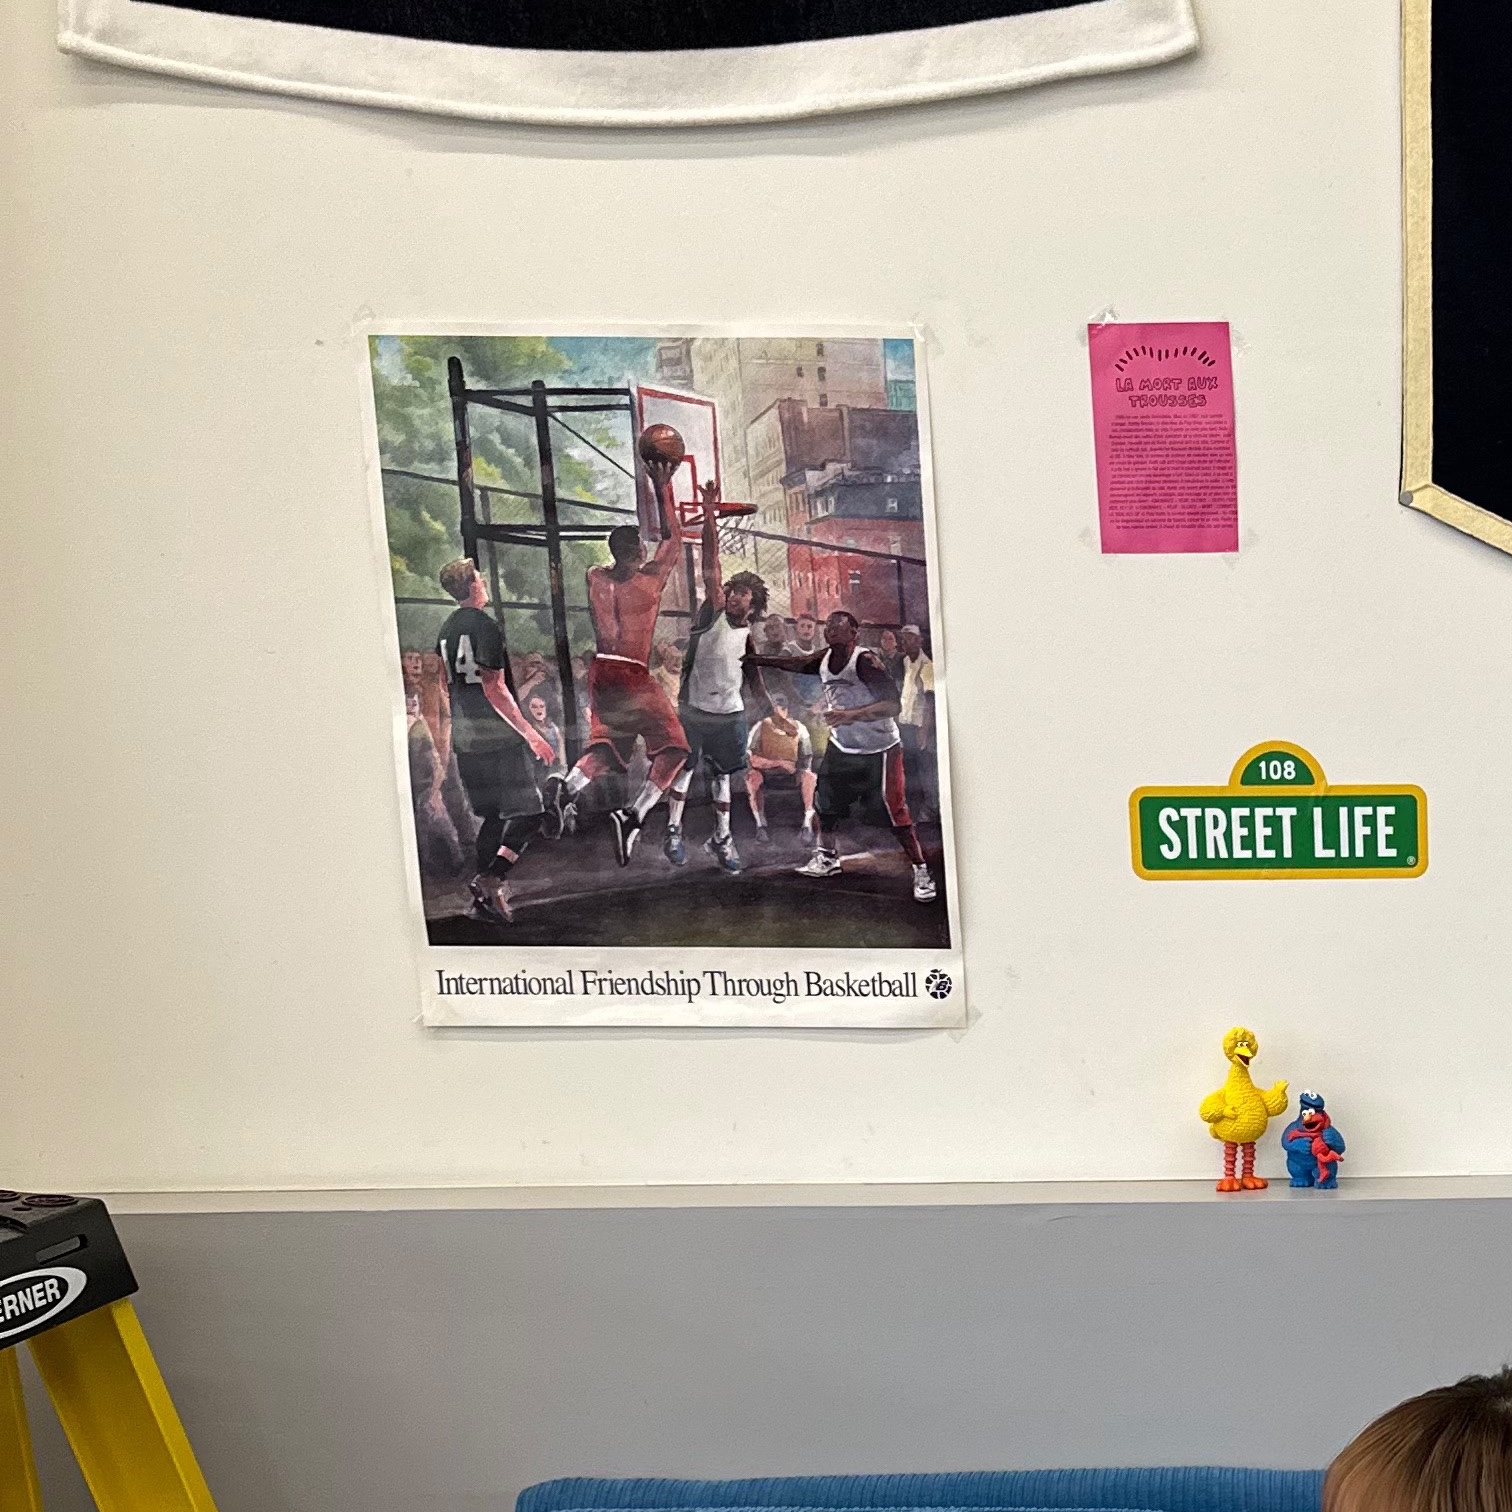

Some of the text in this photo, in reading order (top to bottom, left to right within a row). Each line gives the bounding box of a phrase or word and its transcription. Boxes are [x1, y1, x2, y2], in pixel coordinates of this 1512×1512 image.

[1116, 376, 1218, 392] LA MORT AUX
[1128, 394, 1207, 408] TROUSSES
[440, 634, 482, 684] 14
[1259, 760, 1296, 780] 108
[1158, 805, 1397, 860] STREET LIFE
[436, 969, 918, 1003] International Friendship Through Basketball
